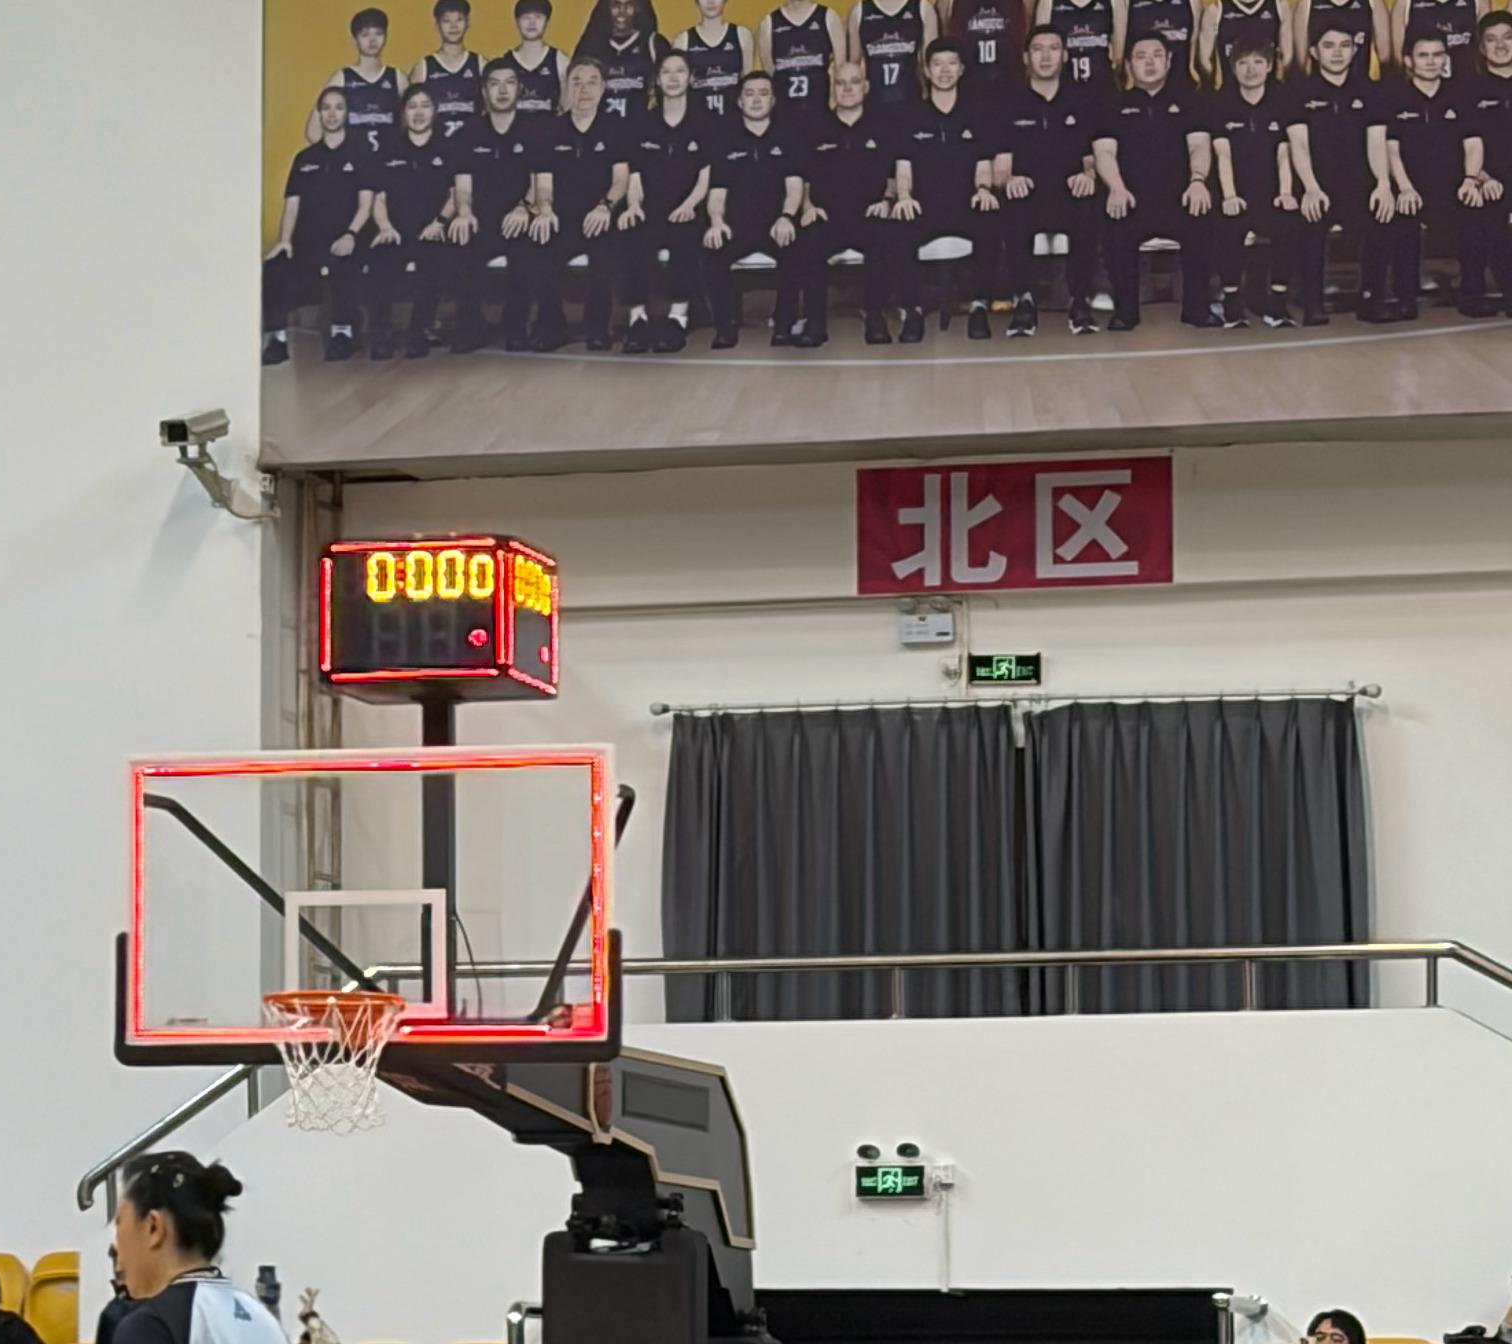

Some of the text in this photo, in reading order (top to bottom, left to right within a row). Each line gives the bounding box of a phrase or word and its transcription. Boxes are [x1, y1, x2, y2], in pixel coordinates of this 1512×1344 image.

[882, 63, 900, 86] 17
[787, 75, 809, 98] 23
[891, 470, 1139, 587] 北区
